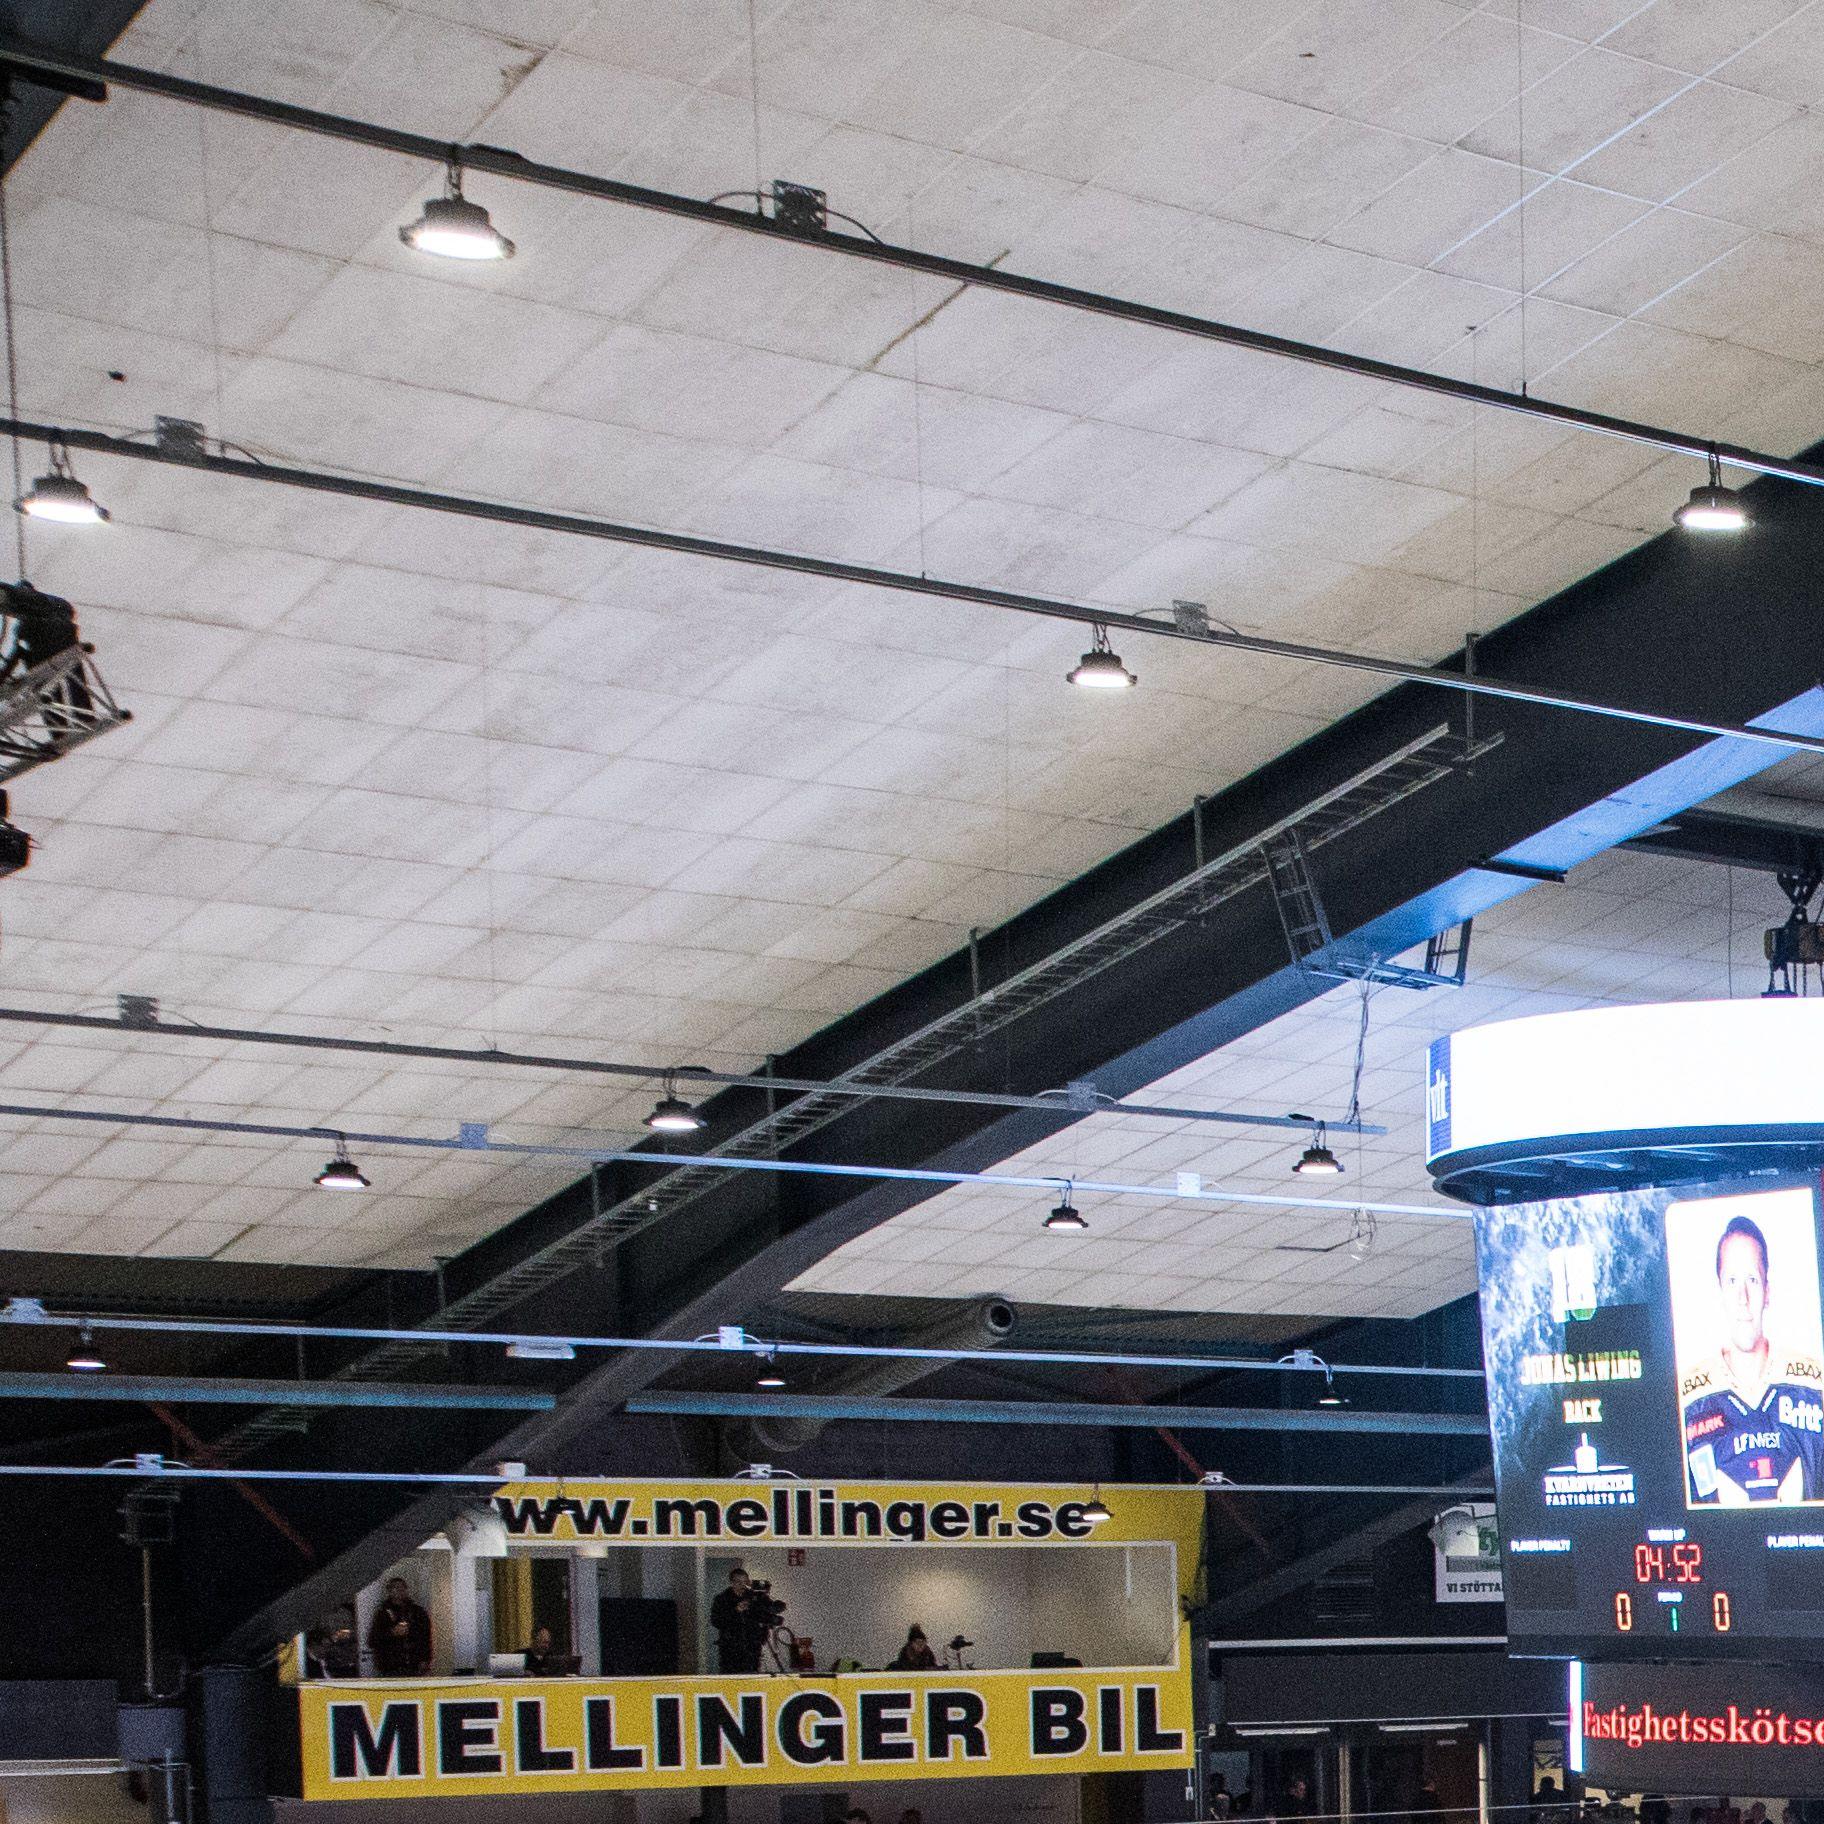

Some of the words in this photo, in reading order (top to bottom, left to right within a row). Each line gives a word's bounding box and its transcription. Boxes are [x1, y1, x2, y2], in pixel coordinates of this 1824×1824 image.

[1636, 1545, 1702, 1582] 04:52
[1616, 1592, 1632, 1631] 0
[1713, 1592, 1730, 1631] 0
[329, 1688, 989, 1781] MELLINGER
[1030, 1683, 1186, 1760] BIL
